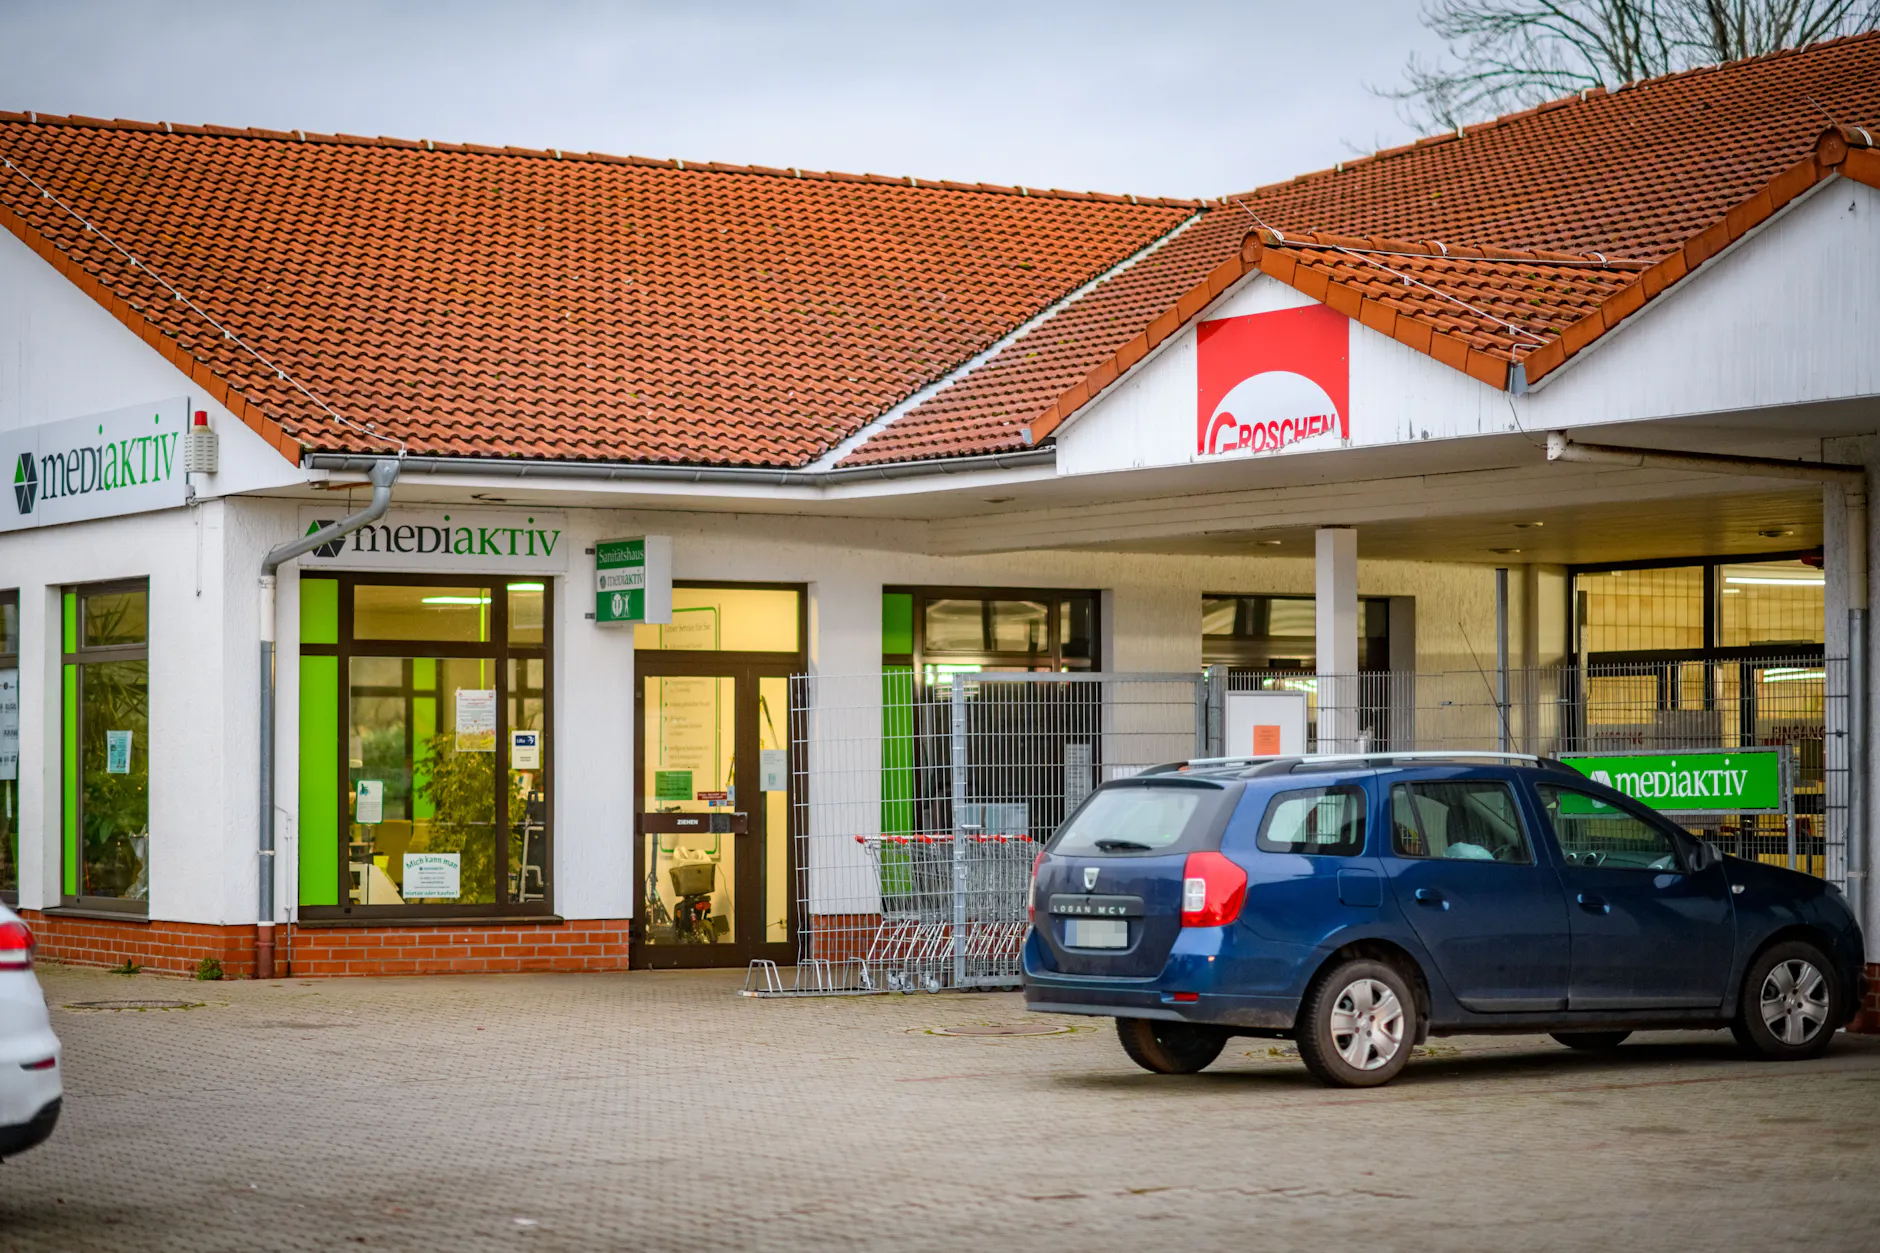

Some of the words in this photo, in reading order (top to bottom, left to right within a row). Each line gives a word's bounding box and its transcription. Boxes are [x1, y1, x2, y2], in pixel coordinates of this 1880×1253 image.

[1209, 411, 1336, 455] GROSCHEN
[599, 546, 644, 563] Sanitätshaus
[405, 857, 424, 869] Mich
[443, 859, 458, 869] man
[1053, 905, 1091, 914] LOGAN
[1098, 906, 1126, 915] MCV
